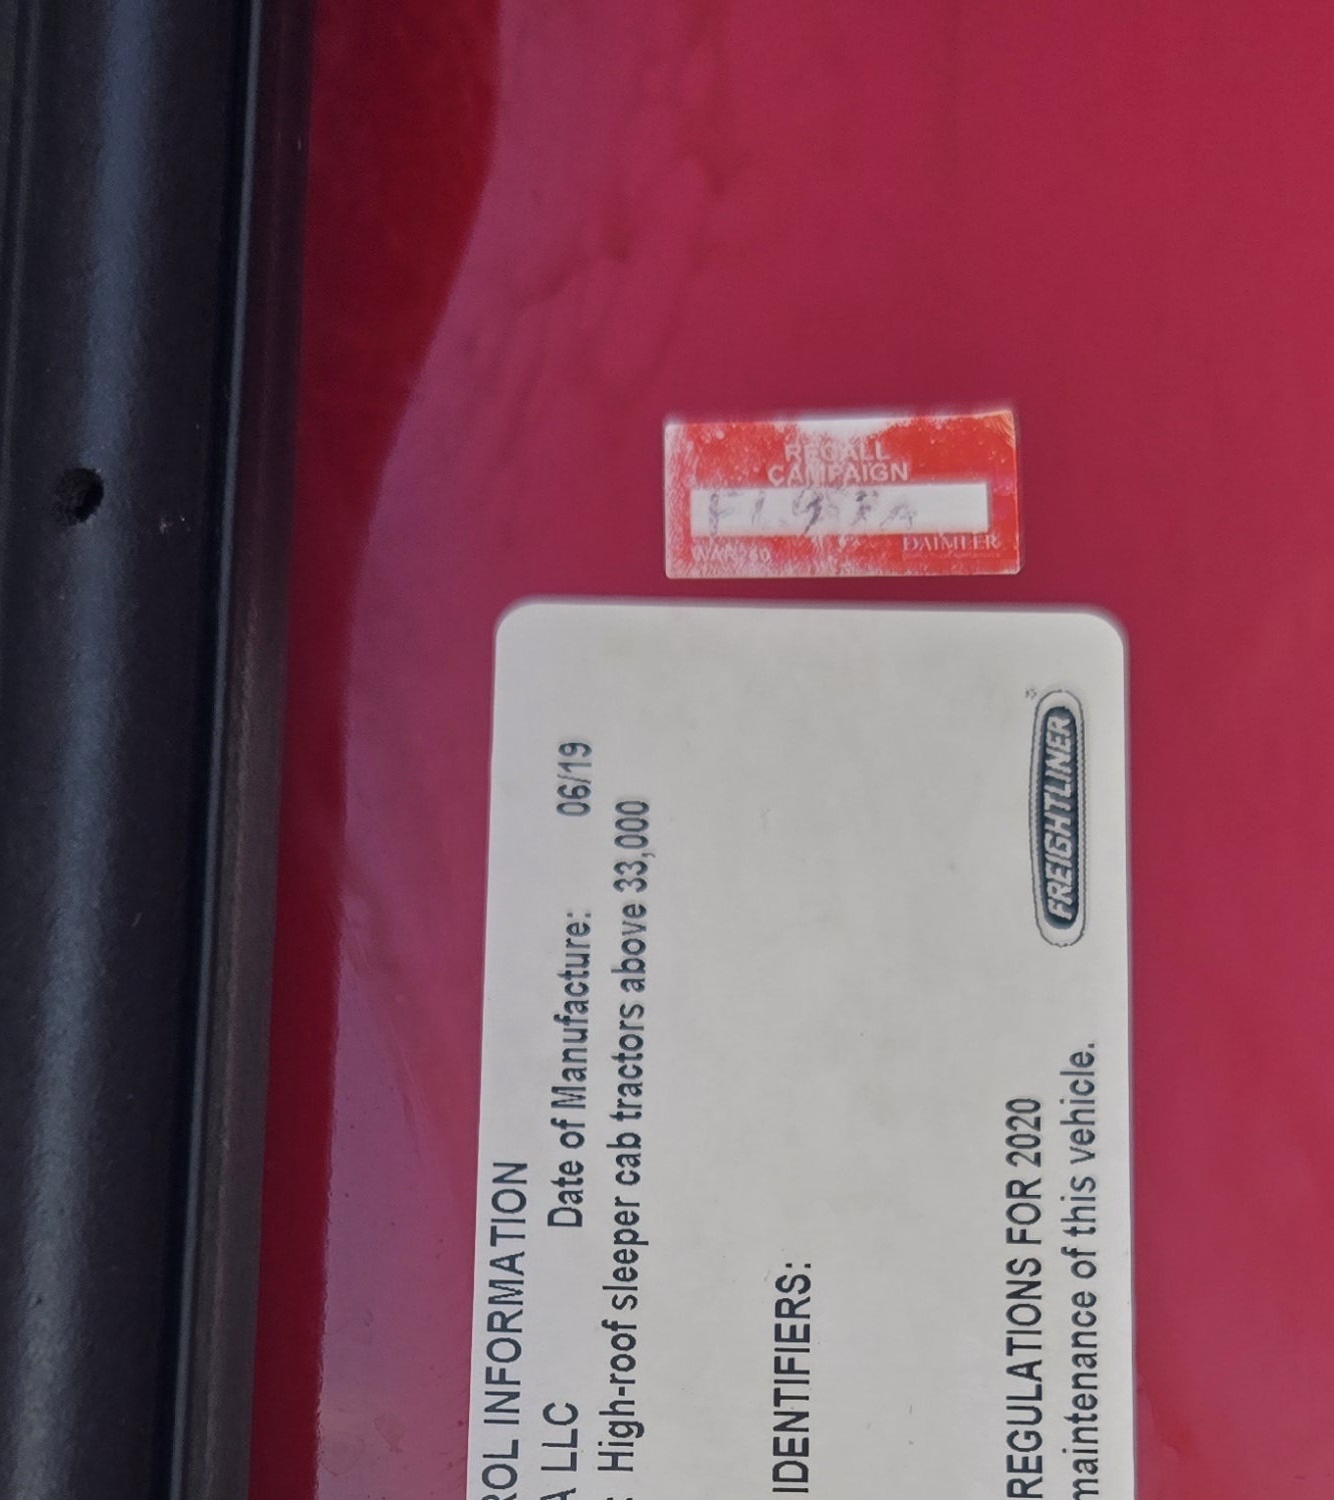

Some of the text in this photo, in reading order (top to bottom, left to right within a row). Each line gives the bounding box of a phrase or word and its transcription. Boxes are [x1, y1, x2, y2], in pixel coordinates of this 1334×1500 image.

[767, 462, 909, 486] CAMPAIGN
[613, 801, 655, 893] 33,000
[1043, 715, 1072, 921] FREIGHTLINER
[547, 742, 592, 1228] Date of Manufacture: 06/19
[611, 904, 647, 993] above
[609, 1003, 645, 1122] tractors
[1059, 1043, 1096, 1165] vehicle.
[606, 1132, 641, 1186] cab
[1005, 1098, 1041, 1167] 2020
[602, 1196, 649, 1310] sleeper
[1005, 1178, 1042, 1245] FOR
[1060, 1176, 1096, 1237] this
[484, 1162, 528, 1425] INFORMATION
[1061, 1246, 1097, 1279] of
[597, 1319, 645, 1472] High-roof
[772, 1263, 811, 1493] IDENTIFIERS:
[1006, 1258, 1043, 1499] REGULATIONS
[541, 1402, 578, 1472] LLC
